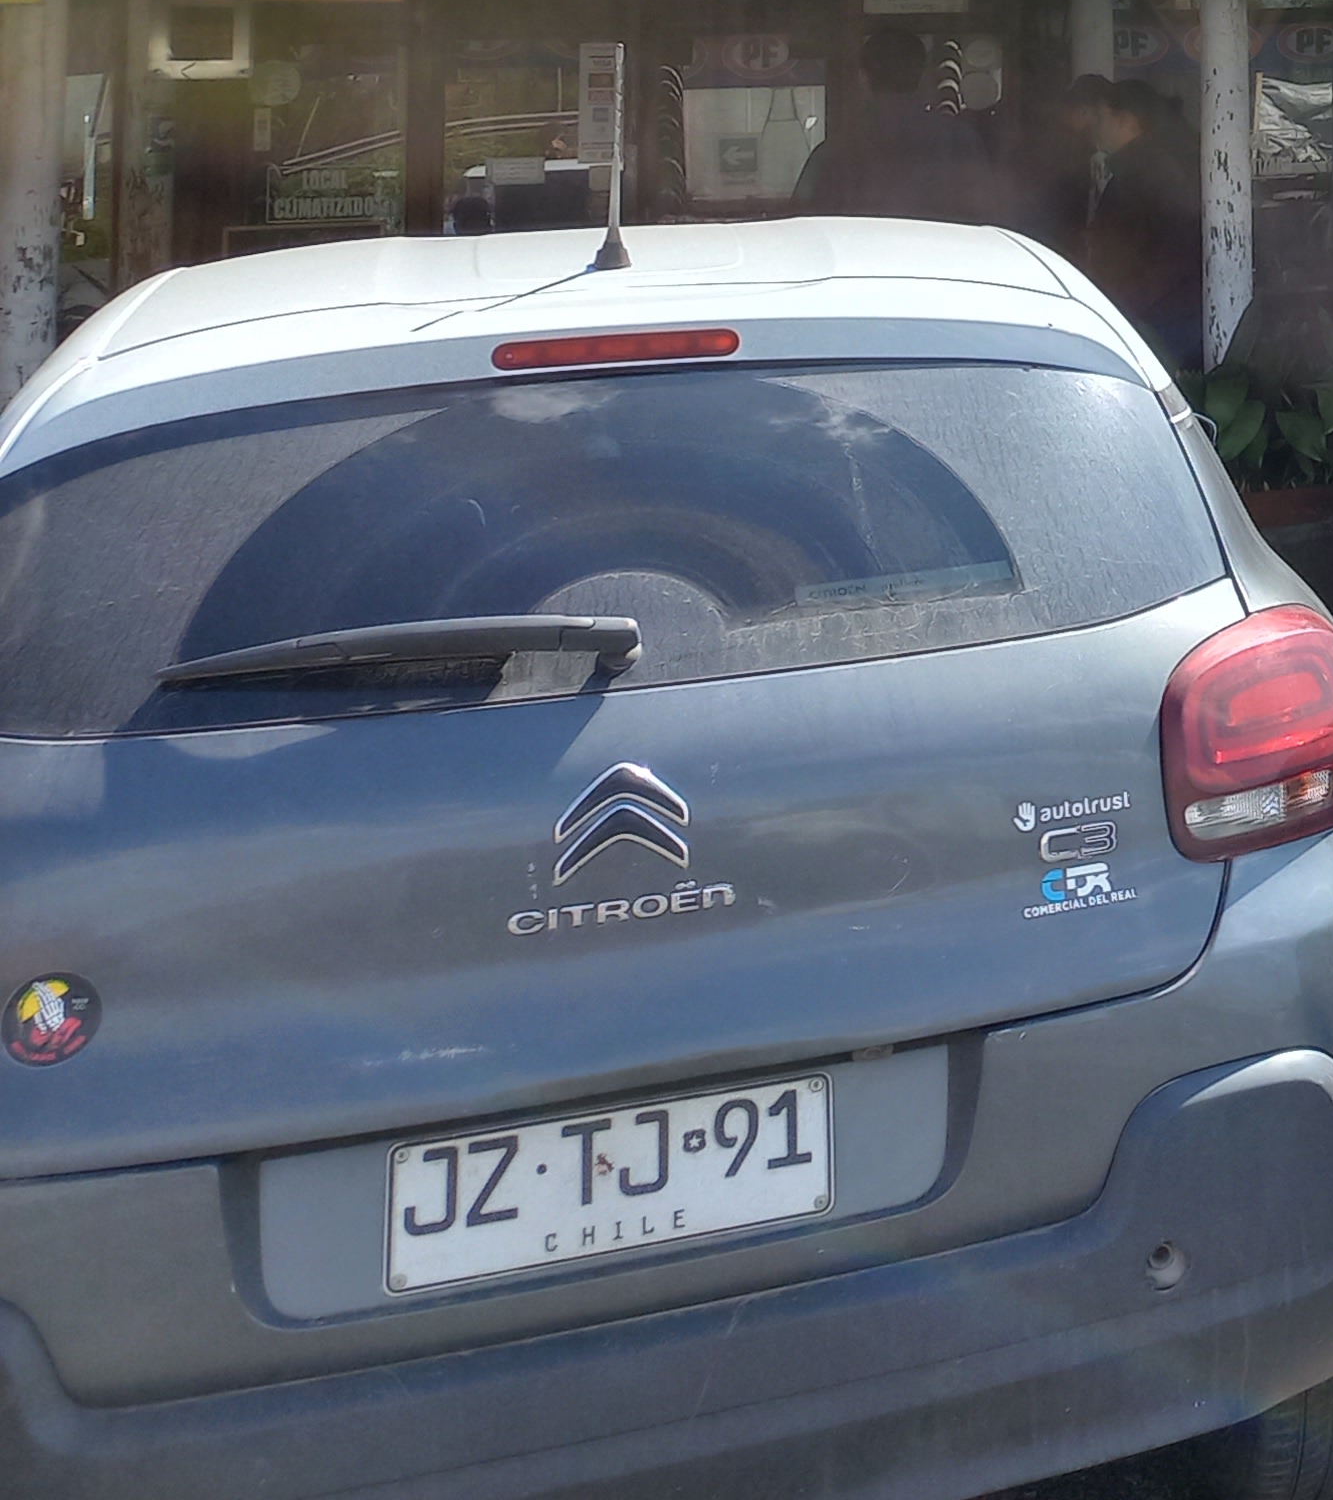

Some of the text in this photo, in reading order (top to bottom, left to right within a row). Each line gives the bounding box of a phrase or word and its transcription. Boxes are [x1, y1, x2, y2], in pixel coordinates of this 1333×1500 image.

[302, 169, 349, 189] LOCAL
[273, 196, 374, 219] CLIMATIZADO
[1040, 791, 1131, 822] autotrust
[1040, 821, 1118, 862] C3
[506, 880, 737, 936] CITROËN
[1023, 888, 1138, 919] COMERCIAL DEL REAL
[544, 1208, 687, 1253] CHILE
